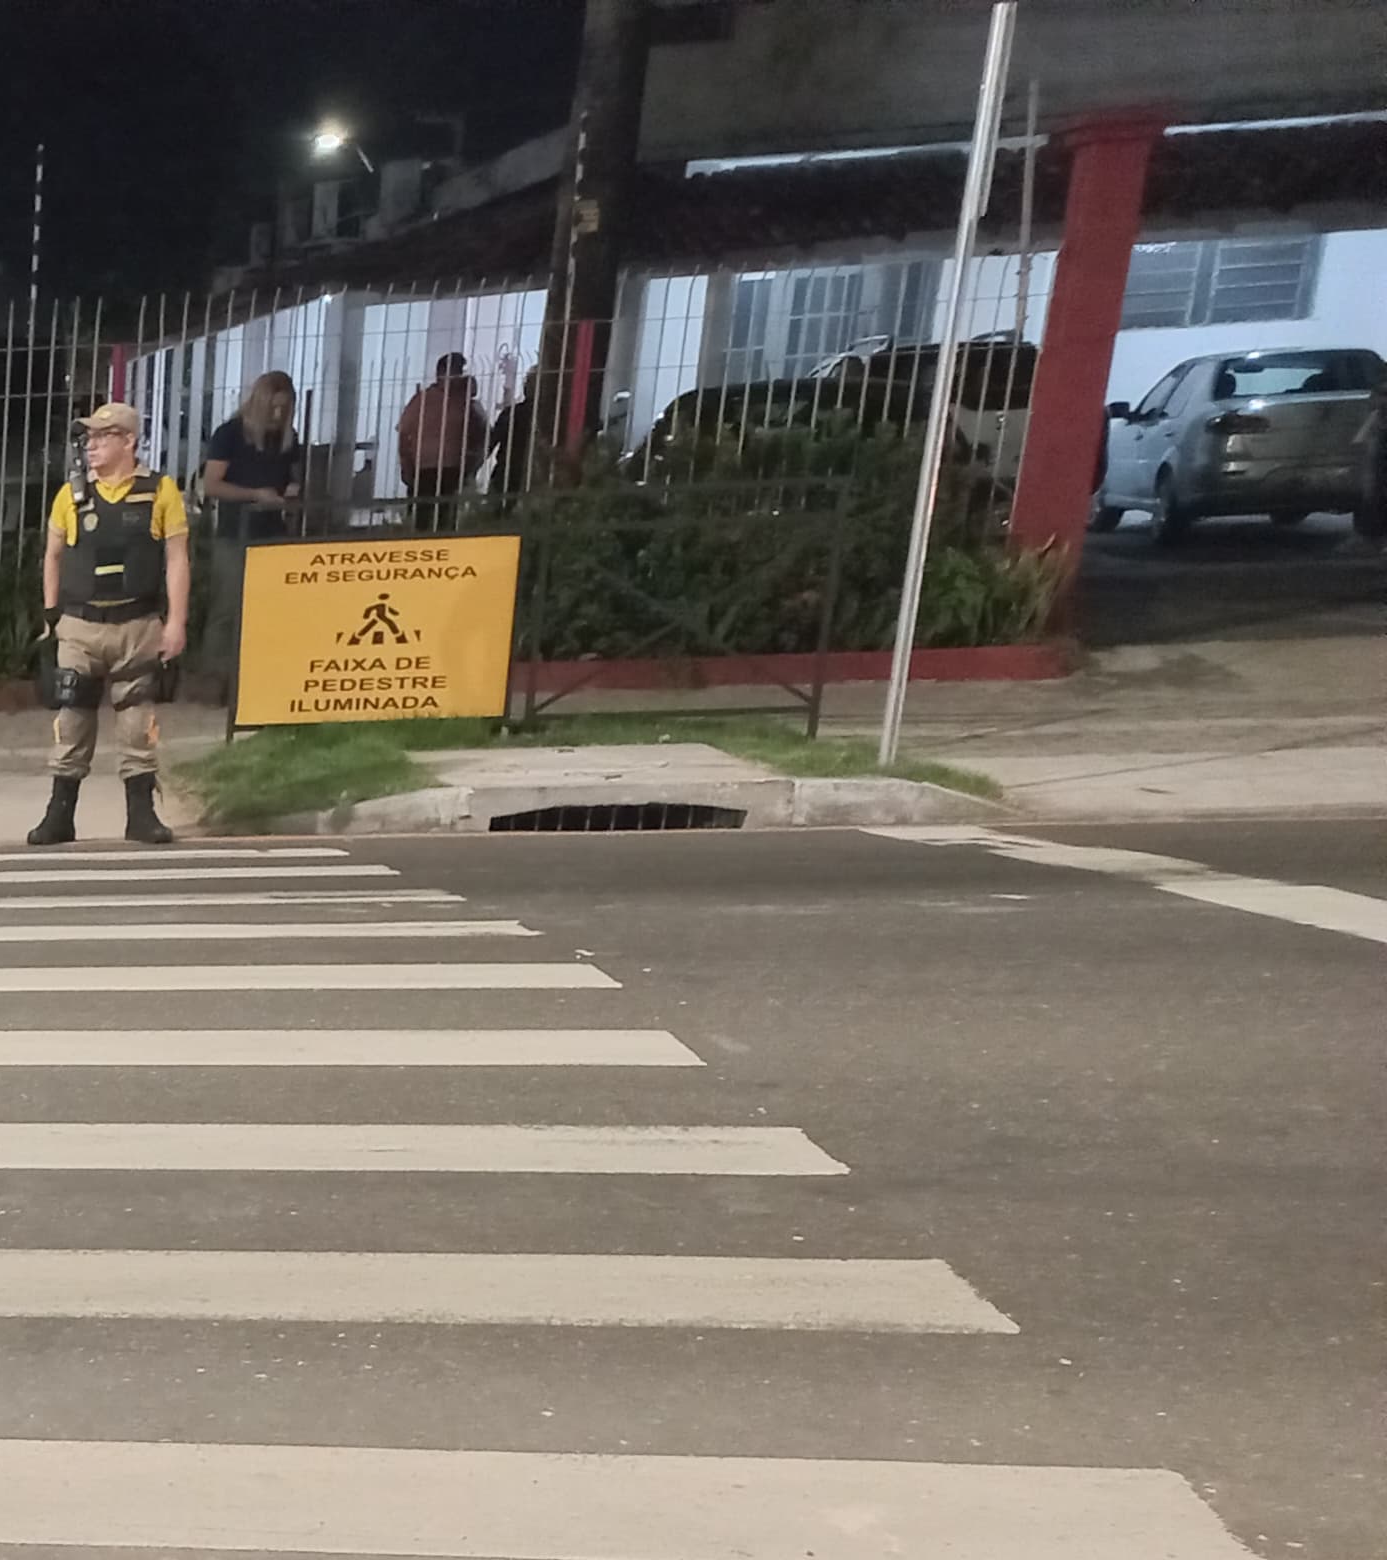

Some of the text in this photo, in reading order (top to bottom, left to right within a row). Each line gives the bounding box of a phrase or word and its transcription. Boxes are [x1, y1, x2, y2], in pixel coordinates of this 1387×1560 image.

[309, 548, 450, 567] ATRAVESSE
[283, 565, 478, 585] EM SEGURANÇA
[309, 655, 431, 673] FAIXA DE
[303, 675, 448, 692] PEDESTRE
[289, 695, 440, 713] ILUMINADA
